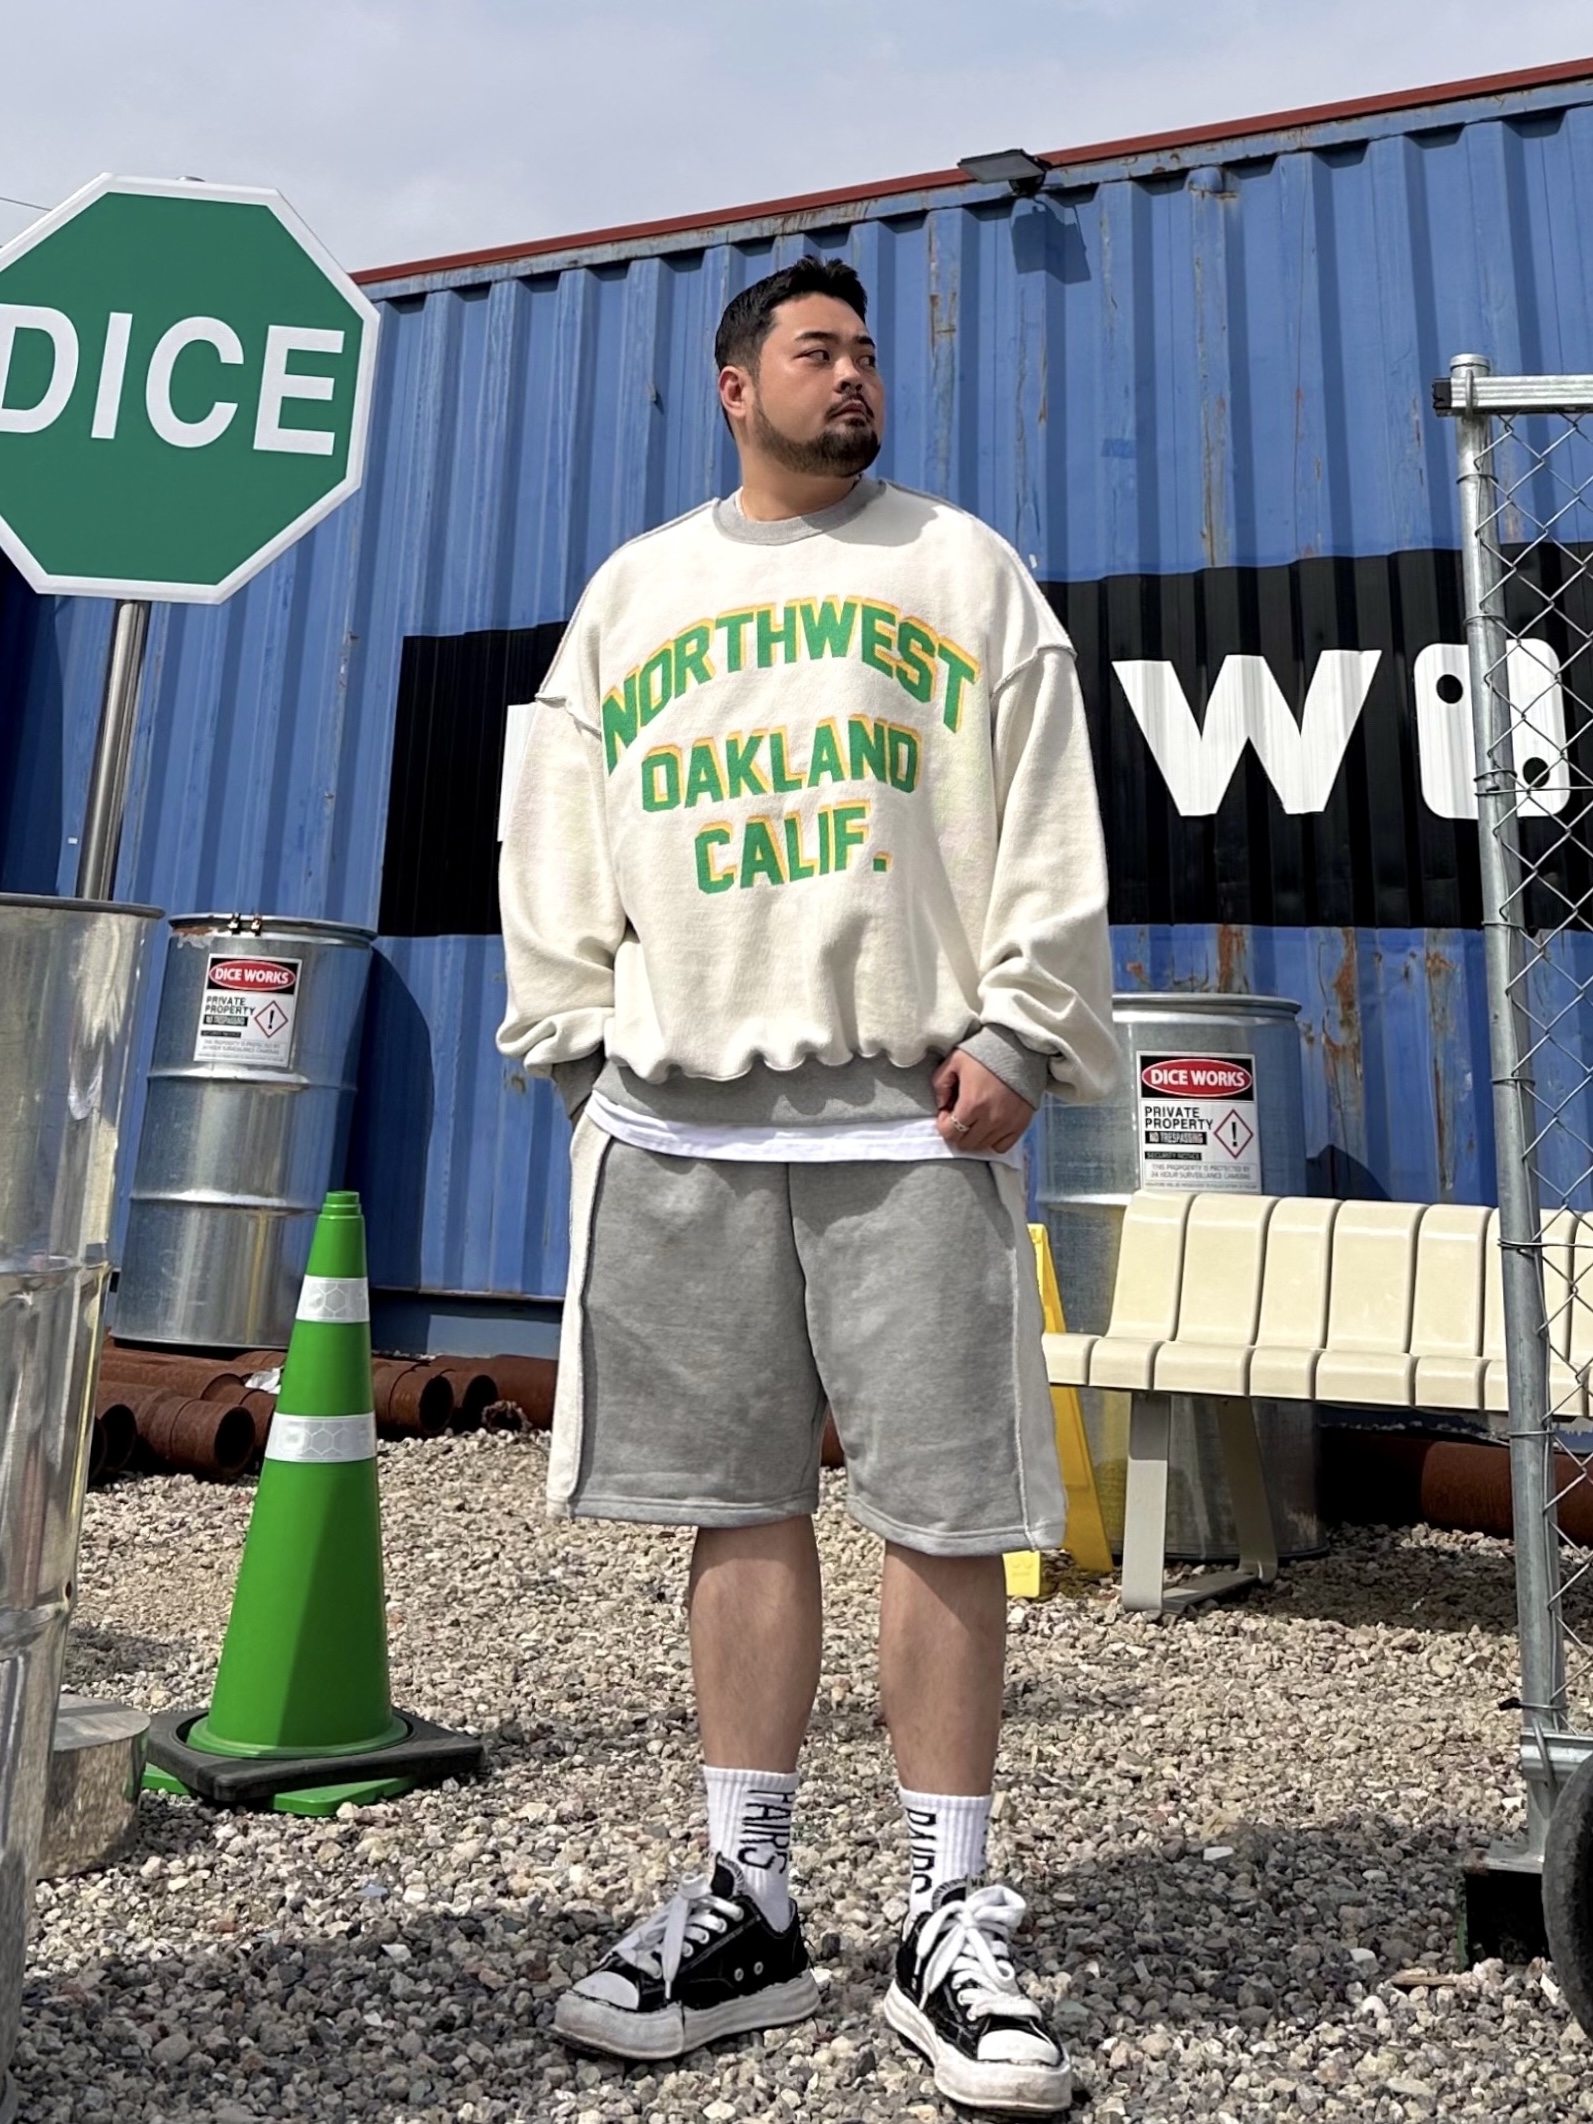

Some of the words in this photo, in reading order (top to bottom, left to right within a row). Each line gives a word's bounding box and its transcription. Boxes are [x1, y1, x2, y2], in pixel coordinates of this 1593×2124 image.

[0, 303, 345, 456] DICE
[601, 594, 981, 777] NORTHWEST
[641, 713, 923, 813] OAKLAND
[694, 798, 892, 894] CALIF.
[214, 968, 242, 981] DICE
[244, 969, 289, 984] WORKS
[206, 996, 245, 1005] PRIVATE
[205, 1005, 255, 1015] PROPERTY
[1150, 1069, 1188, 1085] DICE
[1190, 1070, 1245, 1087] WORKS
[1145, 1106, 1200, 1118] PRIVATE
[1145, 1118, 1213, 1129] PROPERTY
